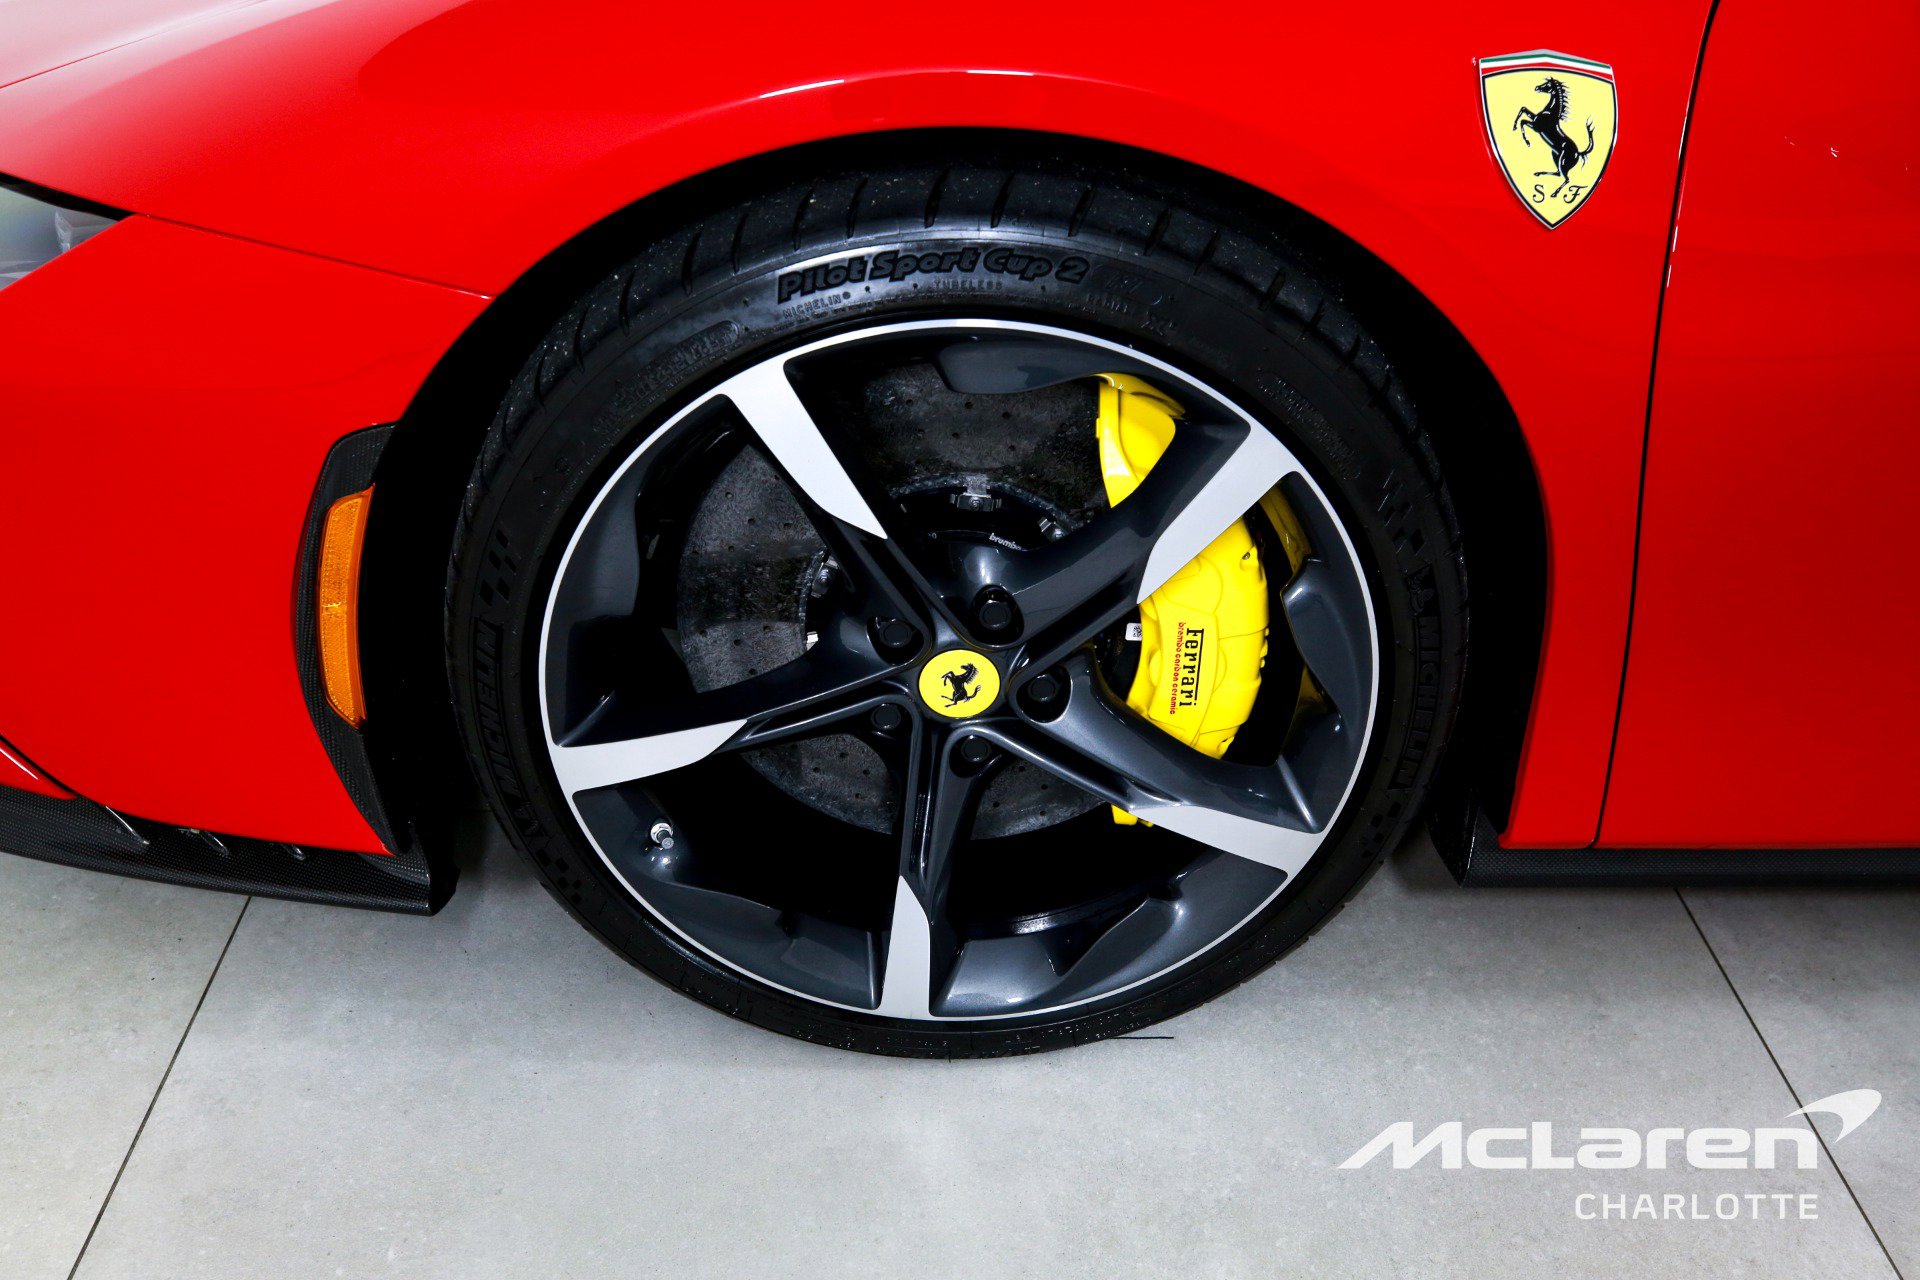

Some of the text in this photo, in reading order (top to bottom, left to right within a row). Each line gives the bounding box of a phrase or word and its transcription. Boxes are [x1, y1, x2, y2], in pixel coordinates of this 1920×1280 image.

[1532, 184, 1588, 204] S F
[778, 256, 867, 304] Pilot
[869, 247, 981, 282] Sport
[983, 248, 1053, 281] Cup
[1055, 256, 1090, 284] 2
[783, 294, 842, 318] MICHELIN
[1169, 622, 1186, 715] brembo carbon ceramic
[1179, 628, 1204, 707] Ferrari
[1390, 614, 1442, 789] MICHELIN
[473, 620, 522, 800] MICHELIN
